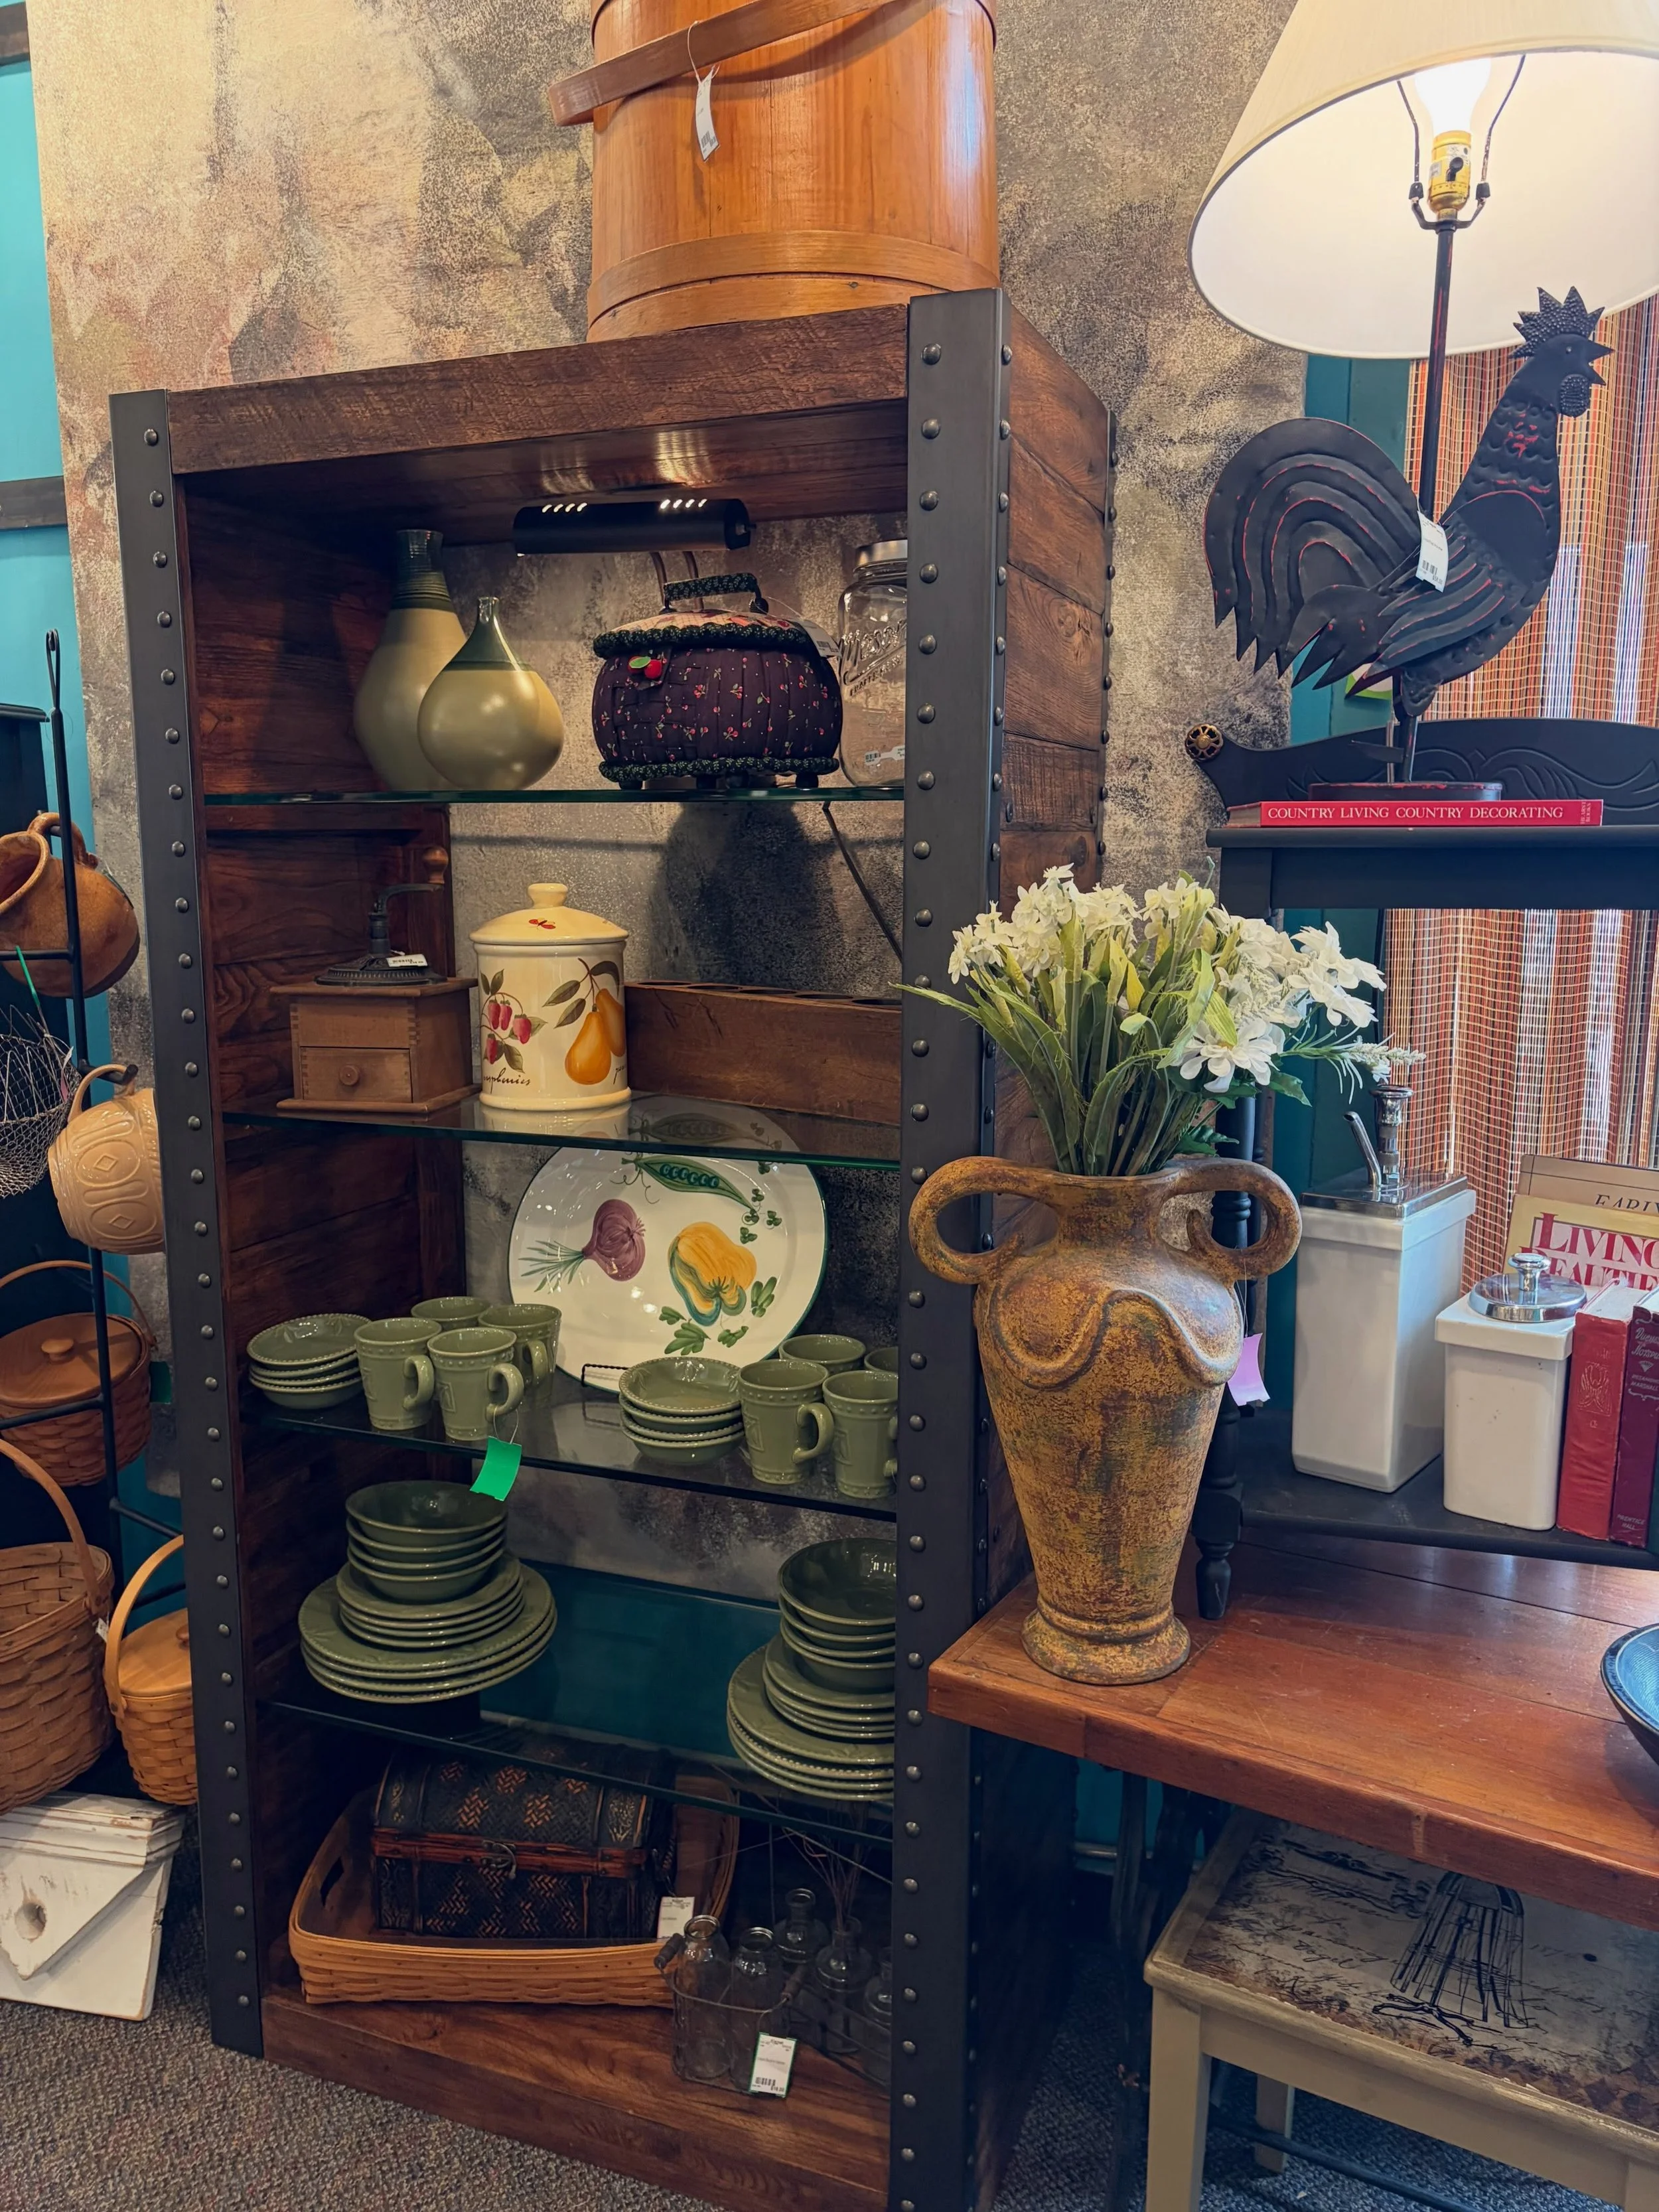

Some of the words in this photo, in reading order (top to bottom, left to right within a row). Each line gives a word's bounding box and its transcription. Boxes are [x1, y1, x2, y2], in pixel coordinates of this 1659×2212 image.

[1267, 807, 1335, 819] COUNTRY
[1340, 807, 1390, 818] LIVING
[1396, 807, 1464, 818] COUNTRY
[1469, 806, 1563, 818] DECORATING
